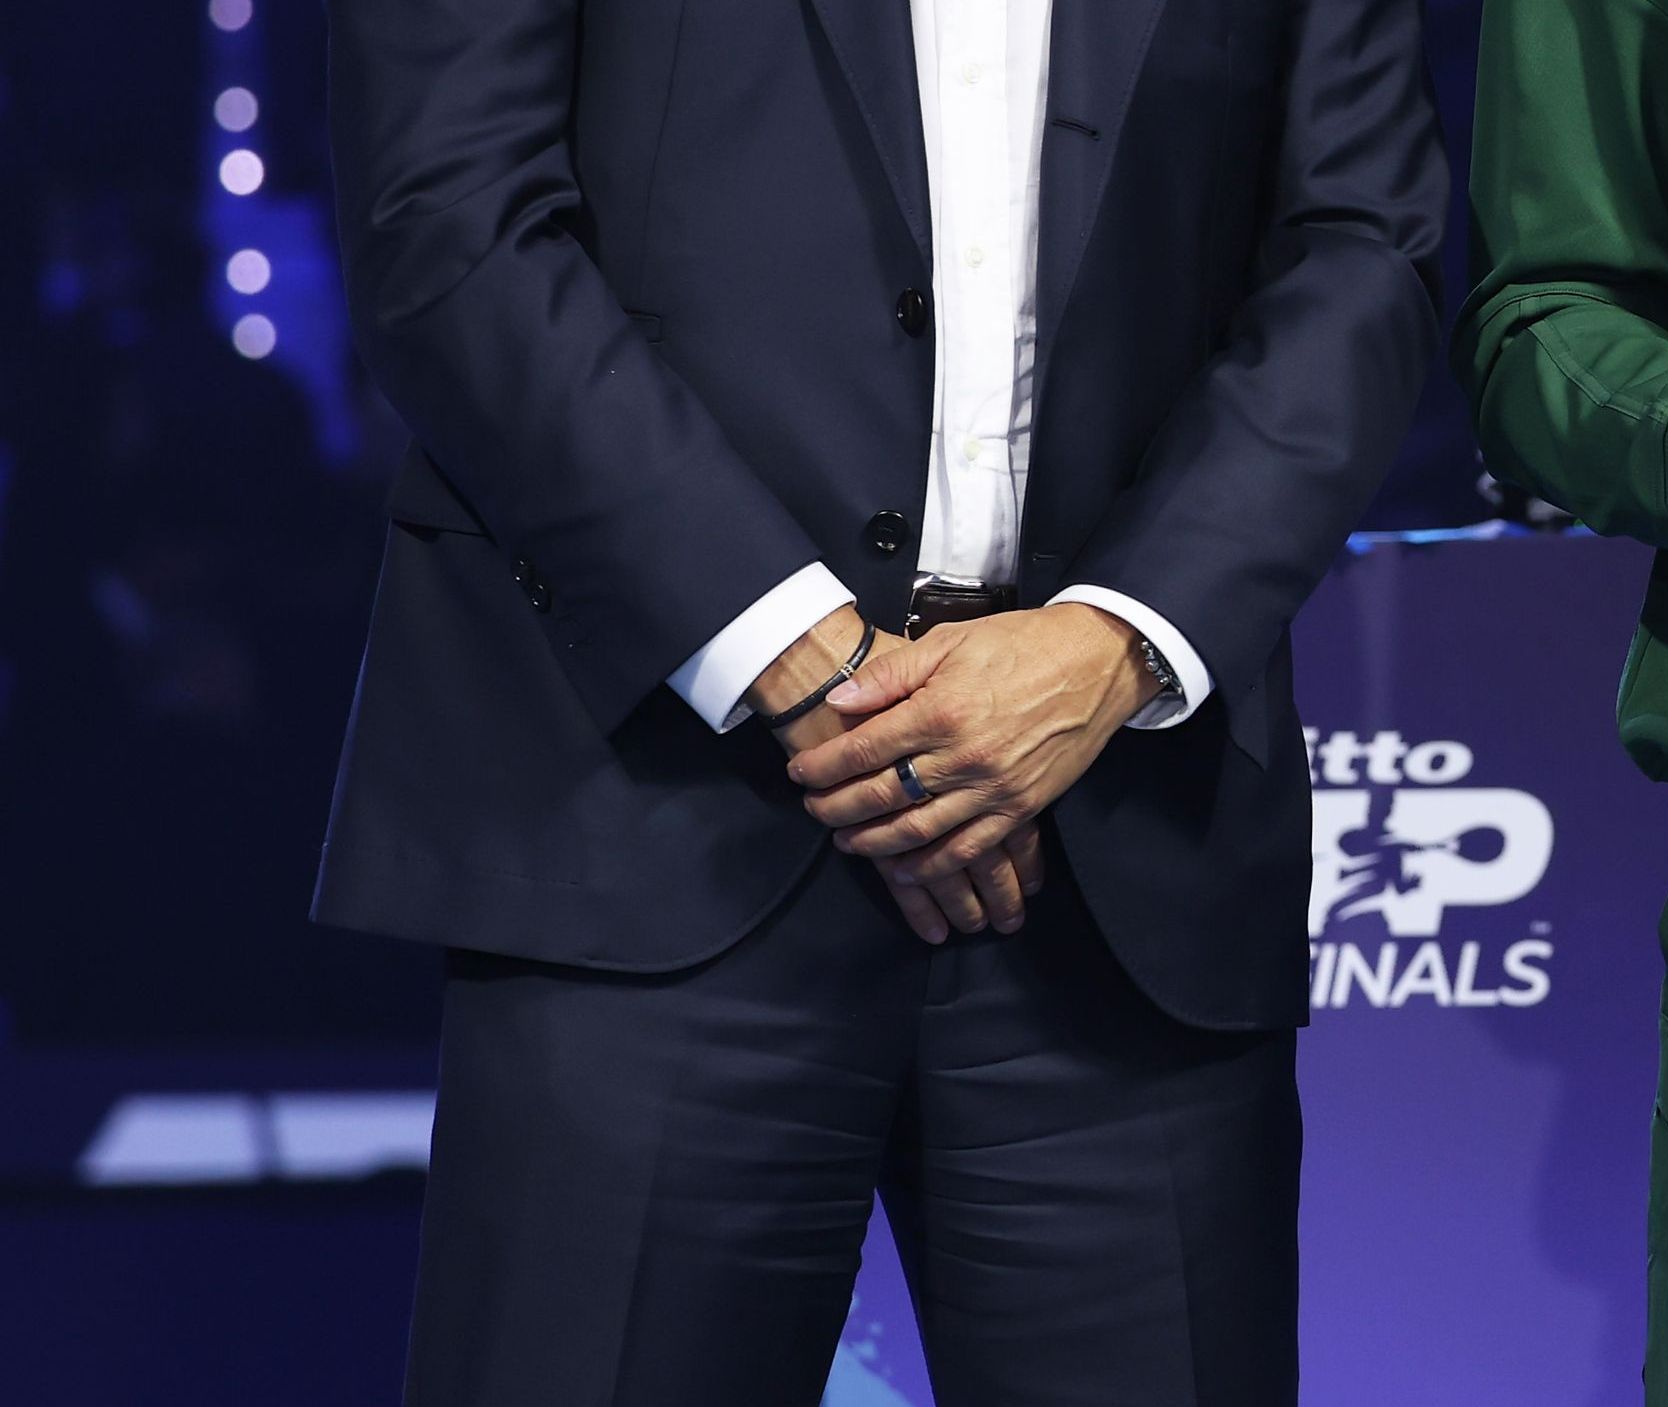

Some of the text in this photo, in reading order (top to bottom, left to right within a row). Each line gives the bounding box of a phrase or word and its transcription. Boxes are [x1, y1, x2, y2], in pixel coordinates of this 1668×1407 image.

[1301, 725, 1475, 786] itto
[1307, 787, 1555, 938] TP
[1308, 939, 1554, 1009] INALS
